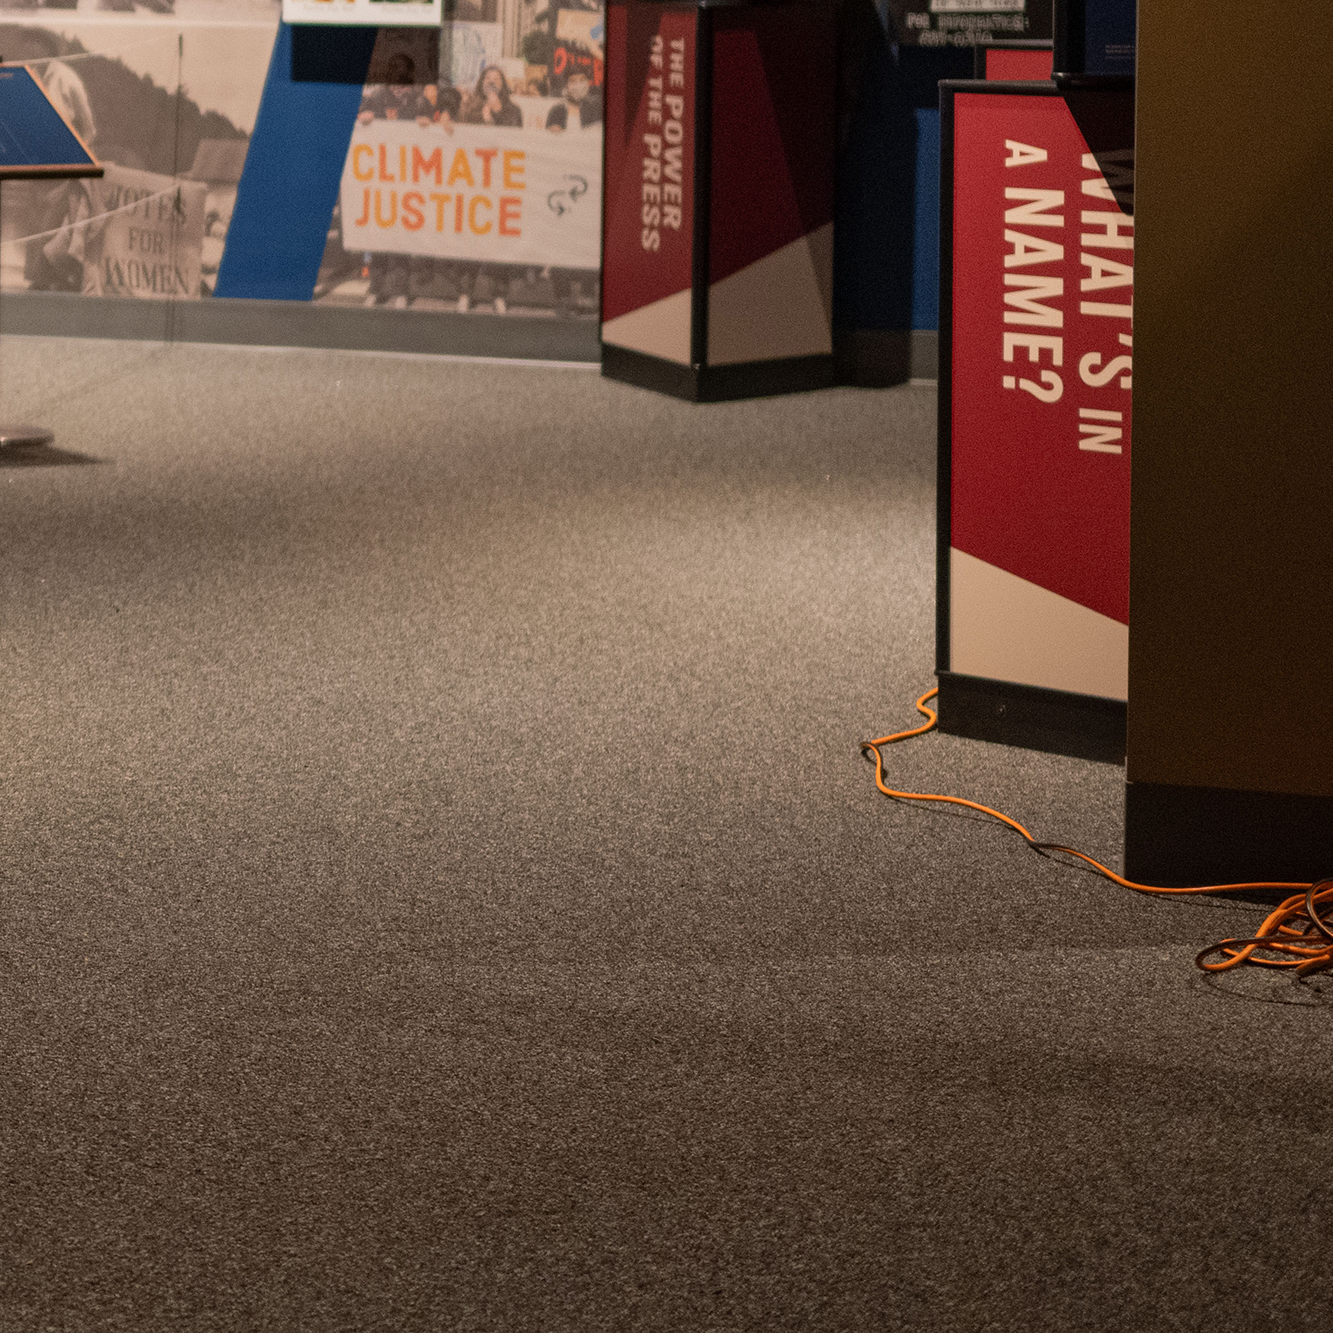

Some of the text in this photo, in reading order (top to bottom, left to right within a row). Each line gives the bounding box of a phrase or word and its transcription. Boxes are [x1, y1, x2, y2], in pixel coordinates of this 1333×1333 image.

[352, 143, 527, 190] CLIMATE
[641, 36, 664, 252] OF THE PRESS
[663, 37, 685, 232] THE POWER
[355, 188, 523, 237] JUSTICE
[1002, 138, 1065, 405] A NAME?
[1078, 407, 1123, 455] IN
